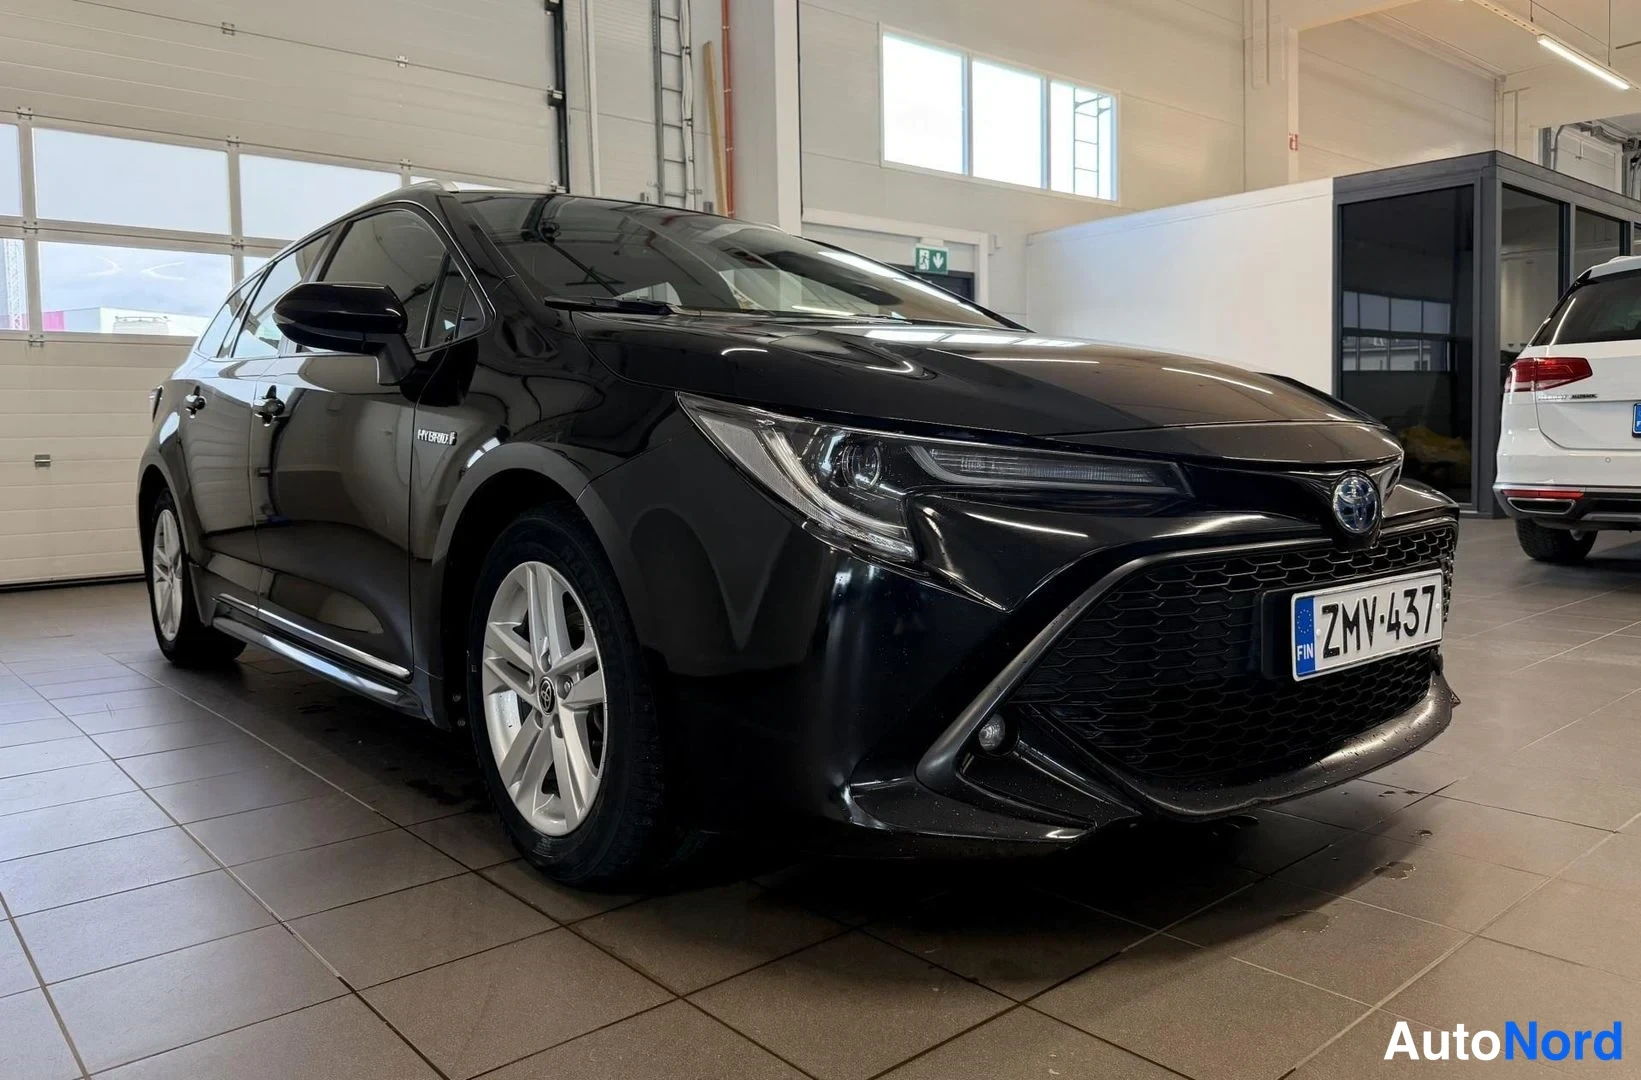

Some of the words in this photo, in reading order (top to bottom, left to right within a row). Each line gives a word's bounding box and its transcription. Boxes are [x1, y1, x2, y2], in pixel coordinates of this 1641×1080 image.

[417, 428, 449, 445] HYBRID
[1321, 585, 1436, 659] ZMV-437
[1297, 643, 1314, 661] FIN
